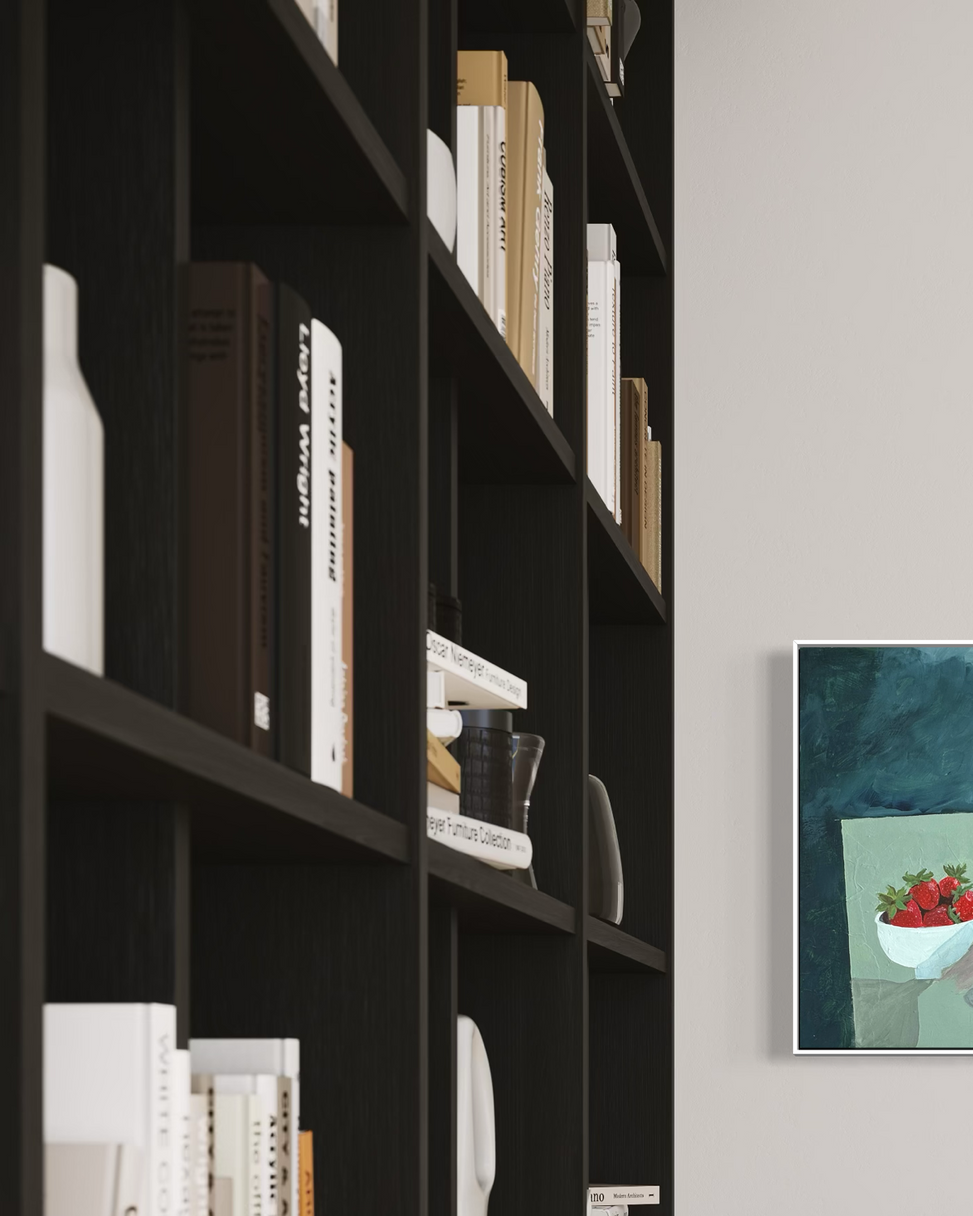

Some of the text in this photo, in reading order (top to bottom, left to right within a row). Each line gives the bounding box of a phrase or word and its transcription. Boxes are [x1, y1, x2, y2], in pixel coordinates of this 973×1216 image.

[536, 120, 544, 199] Frank
[532, 206, 541, 293] Gehry
[544, 189, 553, 252] Renzo
[544, 255, 553, 311] Piano
[296, 322, 311, 528] Lloyd Wright
[327, 467, 338, 584] painting
[427, 631, 448, 659] Oscar
[450, 642, 485, 679] Niemeyer
[447, 816, 478, 842] Furniture
[479, 826, 512, 850] Collection
[281, 1090, 290, 1157] CITY
